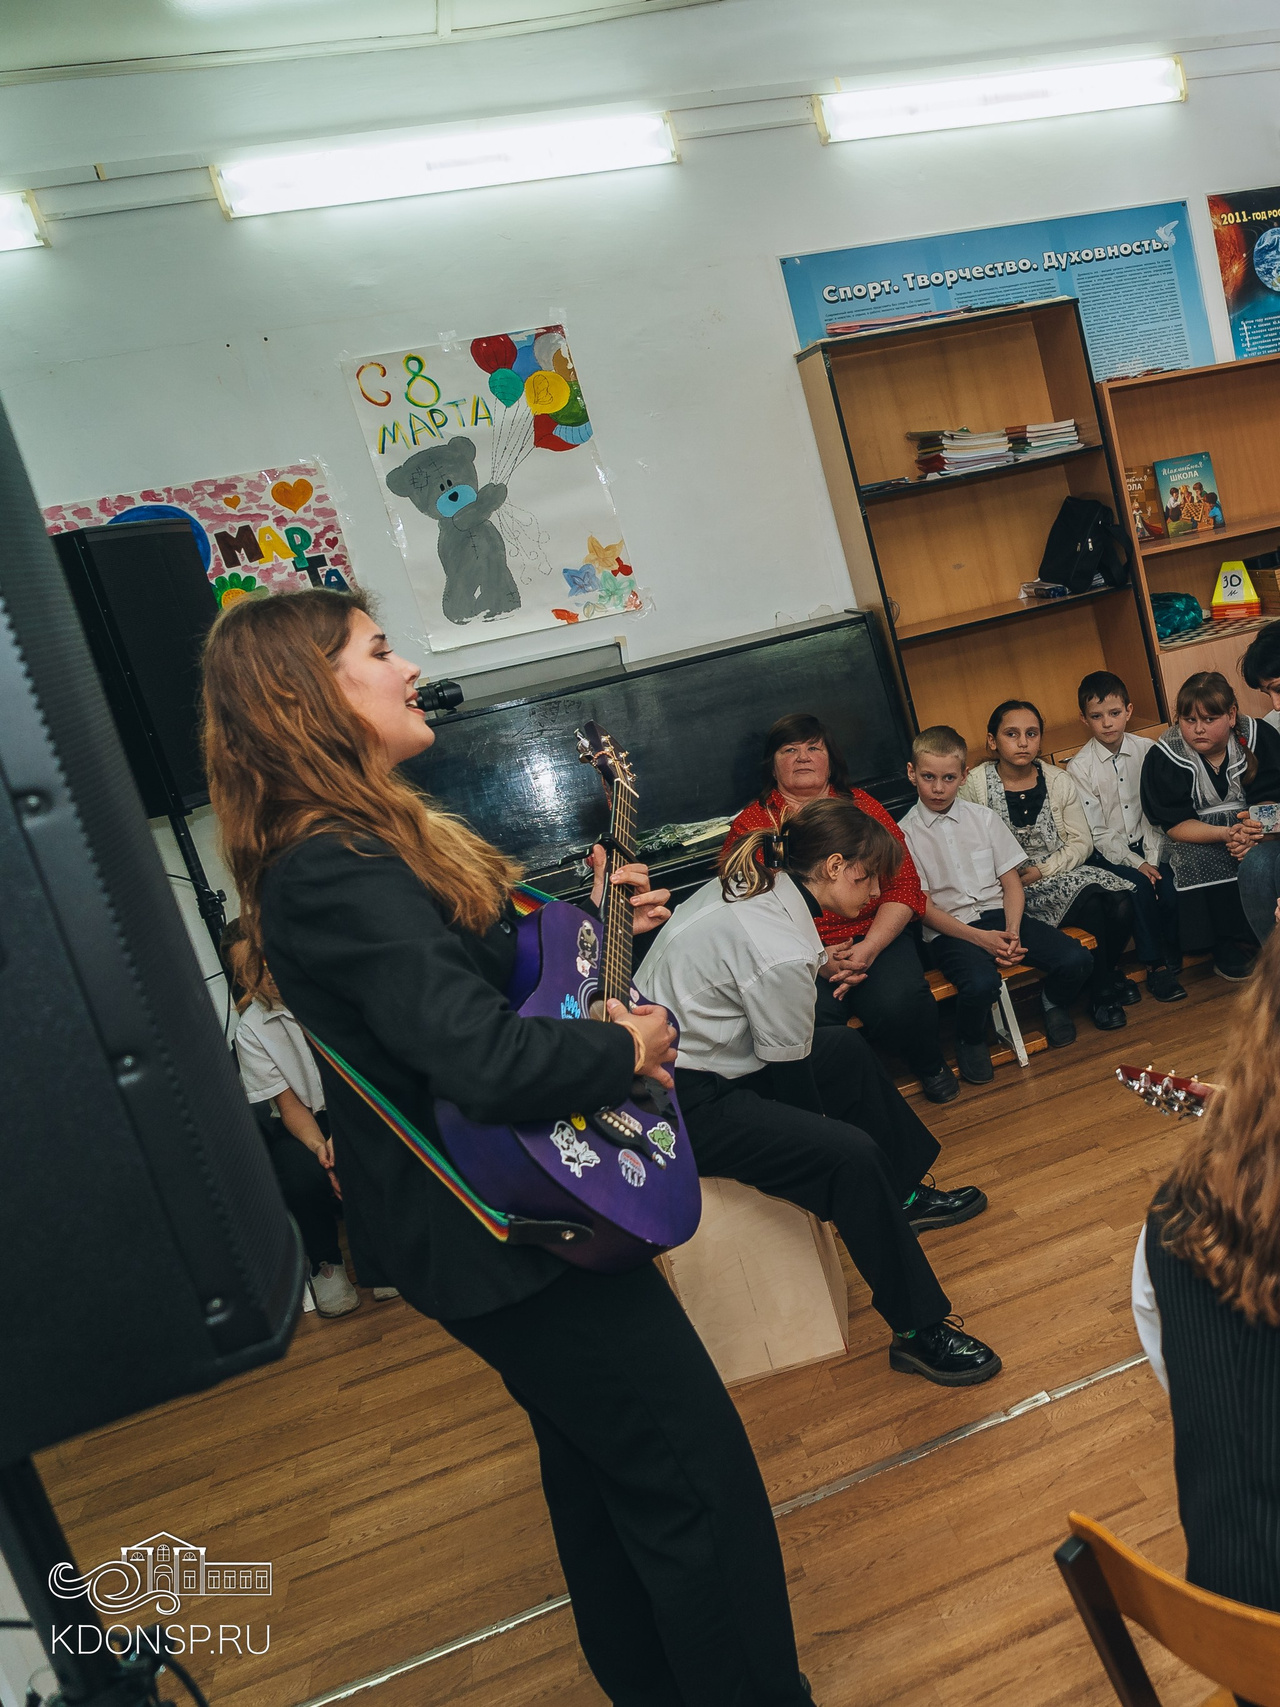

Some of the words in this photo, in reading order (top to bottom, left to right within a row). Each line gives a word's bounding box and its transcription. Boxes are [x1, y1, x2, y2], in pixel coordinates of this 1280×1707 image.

[1252, 208, 1267, 221] ГОД
[822, 278, 900, 304] Спорт.
[903, 257, 1039, 290] Творчество.
[1043, 238, 1170, 272] Духовность.
[356, 361, 392, 408] С
[402, 353, 441, 408] 8
[378, 394, 493, 455] МАРТА
[1127, 483, 1142, 491] ОЛА
[1169, 470, 1199, 482] ШКОЛА
[214, 524, 312, 569] МАР
